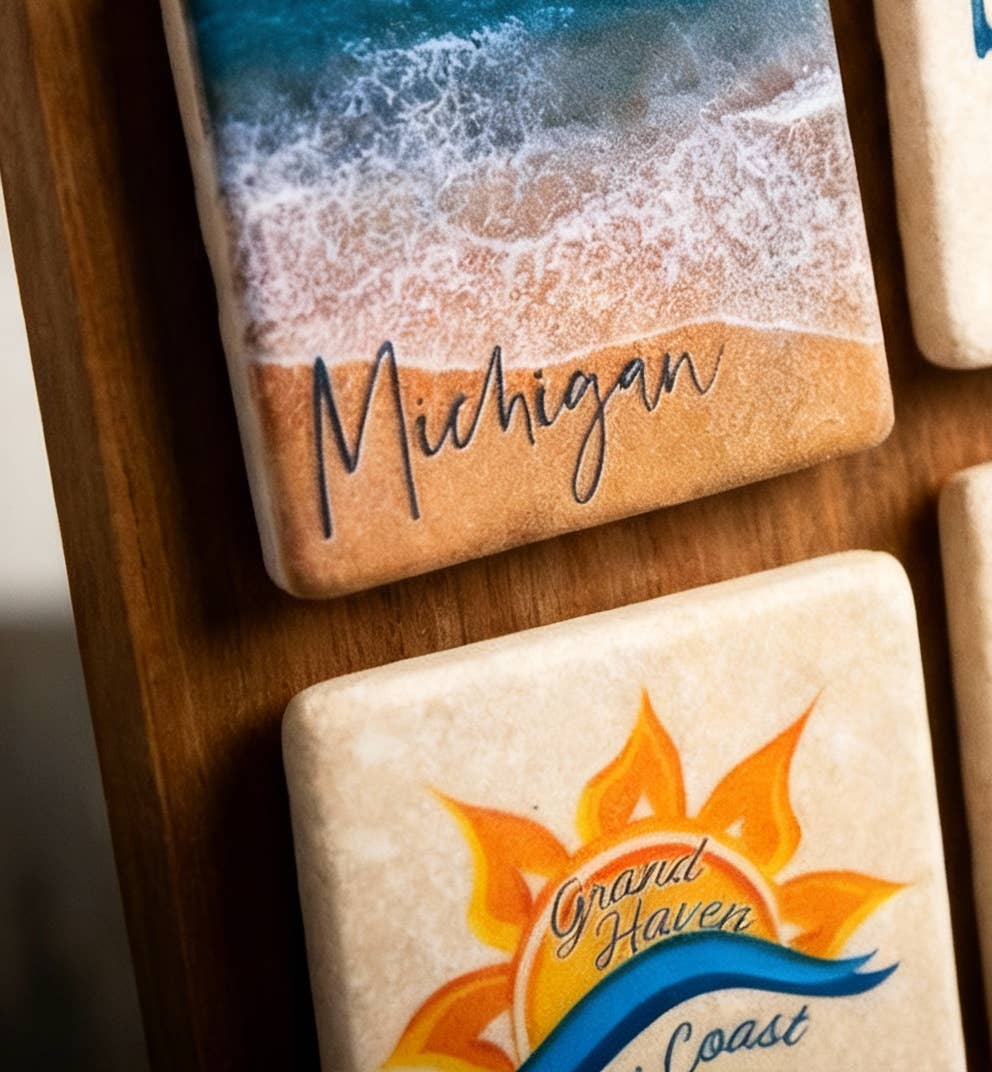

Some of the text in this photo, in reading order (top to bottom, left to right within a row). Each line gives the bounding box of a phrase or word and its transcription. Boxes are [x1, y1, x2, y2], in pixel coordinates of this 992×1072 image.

[312, 339, 725, 540] Michigan
[550, 836, 708, 960] Grand
[594, 897, 759, 972] Haven
[664, 1004, 810, 1072] Coast
